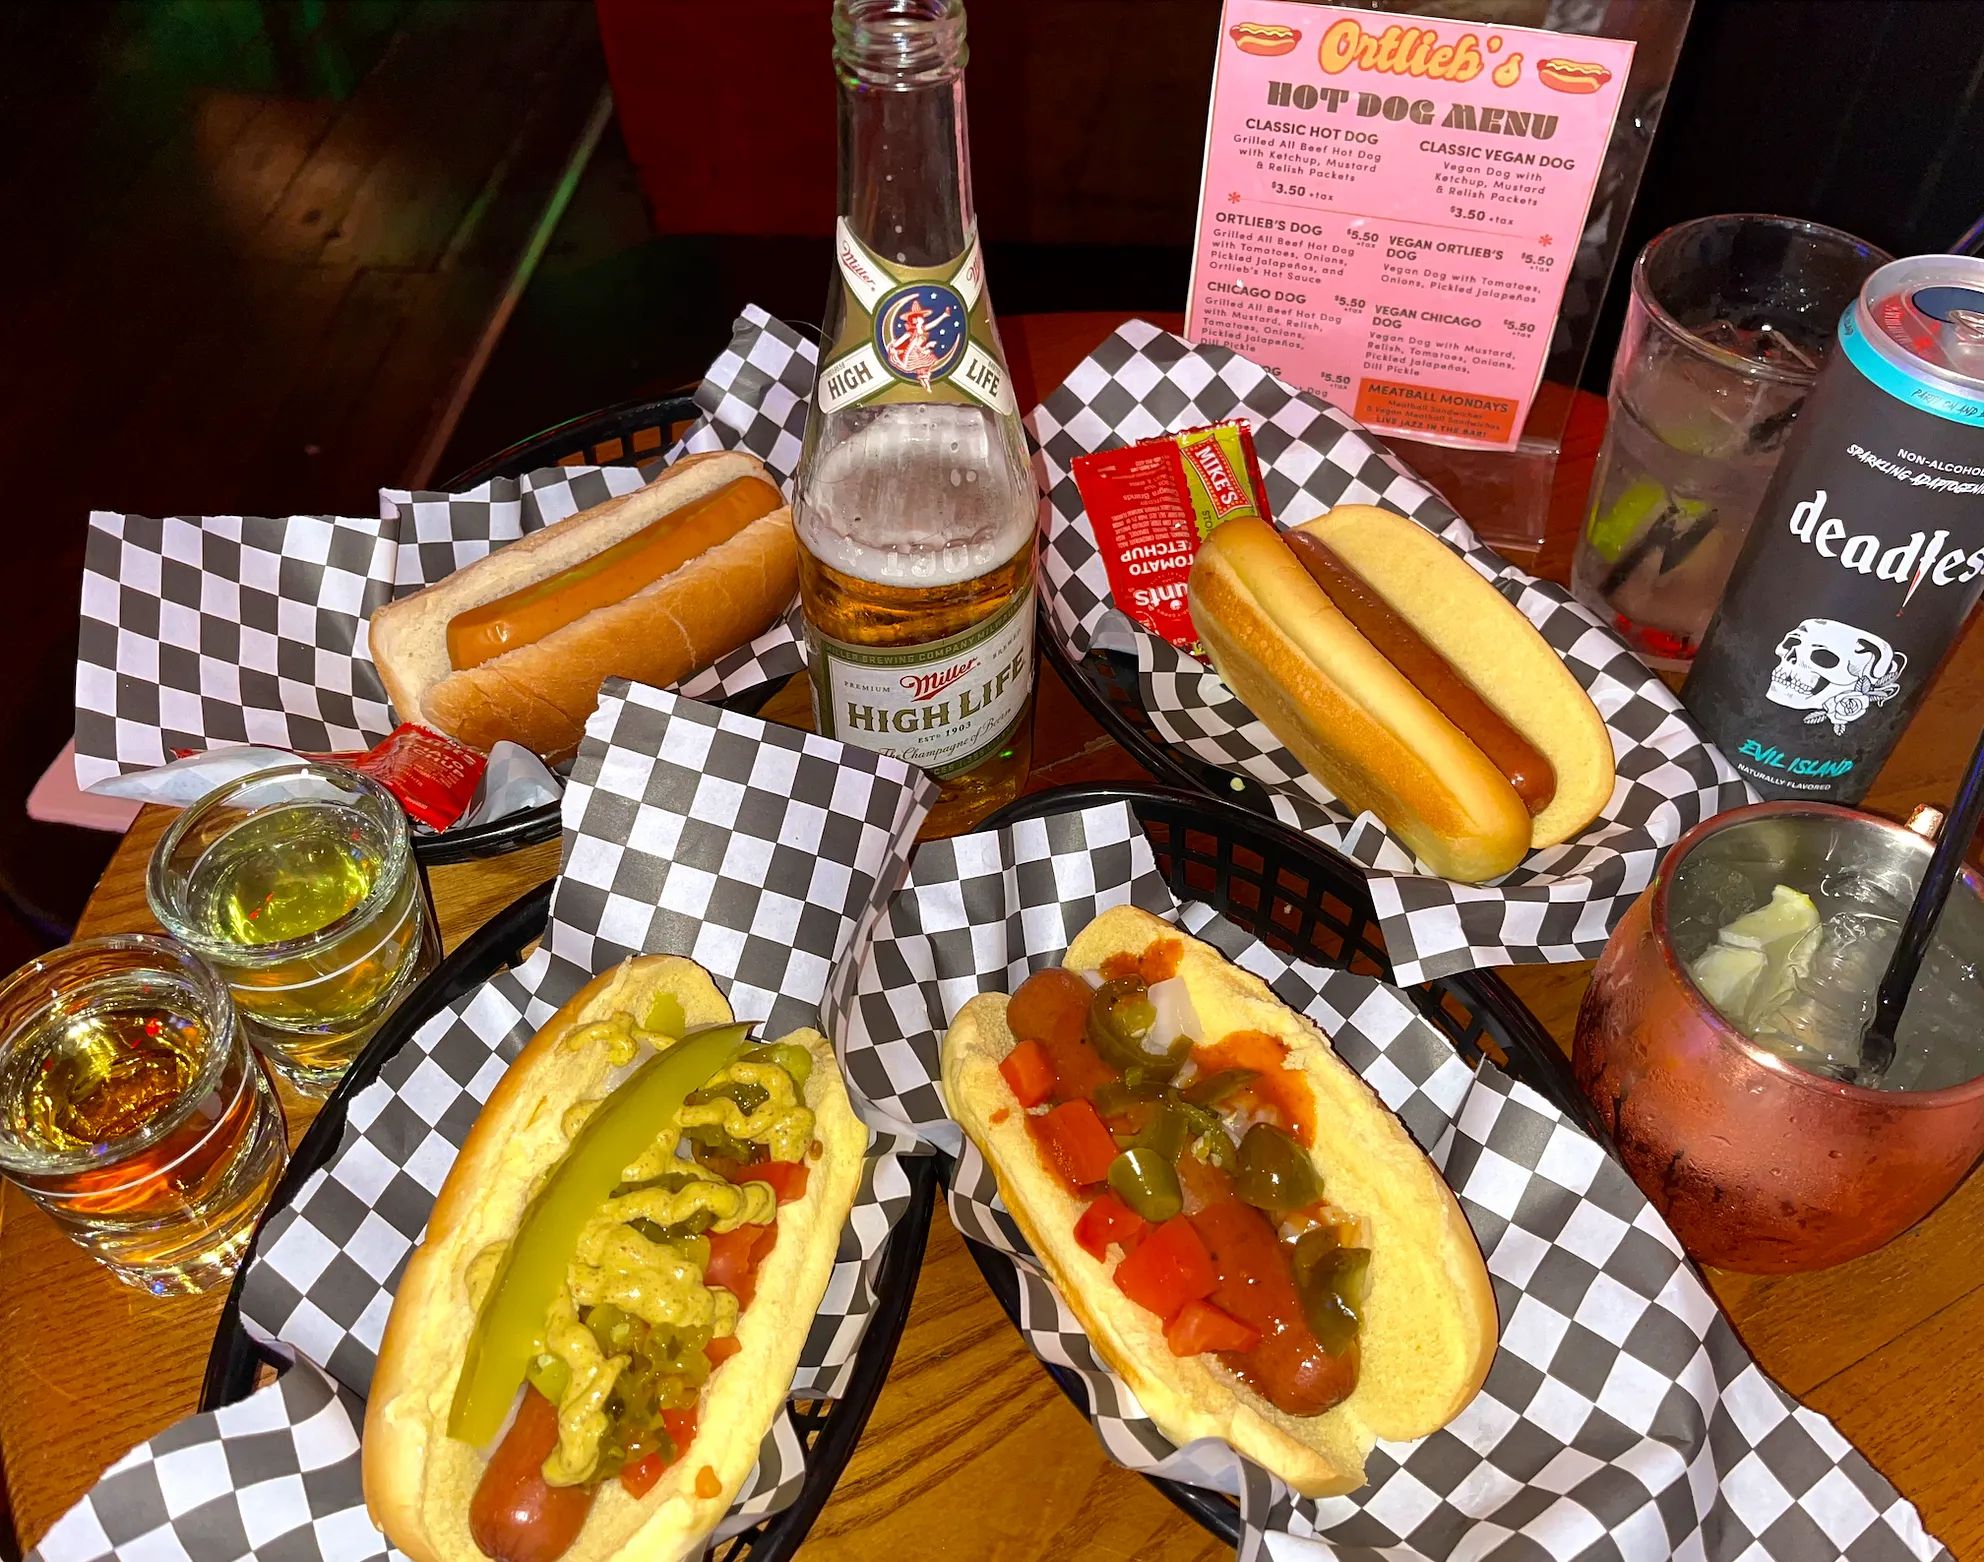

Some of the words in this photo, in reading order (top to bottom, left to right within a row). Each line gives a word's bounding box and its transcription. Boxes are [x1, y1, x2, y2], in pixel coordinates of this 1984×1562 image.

[1318, 18, 1523, 88] Ortlieb's
[1267, 80, 1350, 114] HOT
[1356, 91, 1436, 126] DOG
[1440, 102, 1559, 141] MENU
[1245, 118, 1307, 136] CLASSIC
[1309, 125, 1342, 141] HOT
[1344, 130, 1379, 145] DOG
[1233, 134, 1276, 147] Grilled
[1279, 139, 1296, 150] All
[1299, 142, 1329, 154] Beef
[1332, 146, 1353, 157] Hot
[1357, 150, 1382, 164] Dog
[1238, 147, 1264, 158] with
[1326, 158, 1377, 173] Mustard
[1419, 140, 1483, 159] CLASSIC
[1485, 148, 1536, 166] VEGAN
[1538, 155, 1576, 171] DOG
[1256, 160, 1264, 170] &
[1268, 162, 1304, 175] Relish
[1308, 168, 1355, 182] Packets
[1443, 160, 1481, 174] Vegan
[1486, 166, 1511, 181] Dog
[1515, 171, 1542, 182] with
[1435, 185, 1444, 194] &
[1448, 186, 1485, 199] Relish
[1490, 192, 1538, 206] Packets
[1492, 180, 1546, 195] Mustard
[1215, 211, 1286, 231] ORTLIEB'S
[1289, 221, 1323, 236] DOG
[1211, 240, 1236, 250] with
[1213, 228, 1253, 241] Grilled
[1256, 234, 1273, 244] All
[1277, 237, 1304, 248] Beef
[1307, 241, 1328, 251] Hot
[1331, 244, 1355, 258] Dog
[1386, 248, 1417, 261] DOG
[1389, 235, 1433, 251] VEGAN
[1435, 242, 1504, 261] ORTLIEB'S
[841, 240, 875, 286] Miller
[1210, 250, 1253, 263] Pickled
[1321, 267, 1344, 276] and
[1383, 263, 1419, 276] Vegan
[1423, 268, 1447, 282] Dog
[1451, 274, 1477, 284] with
[1263, 268, 1283, 279] Hot
[1287, 271, 1322, 284] Sauce
[1429, 281, 1473, 295] Pickled
[1207, 281, 1271, 299] CHICAGO
[1274, 290, 1307, 305] DOG
[1203, 308, 1227, 317] with
[1204, 296, 1244, 309] Grilled
[1246, 302, 1263, 312] All
[1266, 305, 1293, 316] Beef
[1296, 309, 1316, 320] Hot
[1319, 312, 1342, 326] Dog
[1371, 316, 1403, 329] DOG
[1375, 304, 1418, 320] VEGAN
[1420, 311, 1482, 329] CHICAGO
[1201, 327, 1242, 340] Pickled
[1369, 330, 1404, 343] Vegan
[1408, 336, 1431, 349] Dog
[1435, 341, 1460, 351] with
[1363, 361, 1383, 371] Dill
[1386, 364, 1420, 377] Pickle
[1365, 351, 1407, 364] Pickled
[828, 361, 874, 400] HIGH
[966, 358, 1000, 398] LIFE
[1262, 365, 1282, 376] OG
[1367, 383, 1437, 402] MEATBALL
[1439, 394, 1509, 413] MONDAYS
[1195, 445, 1239, 506] MIKE'S
[1789, 489, 1984, 607] deadles
[862, 654, 914, 665] BREWING
[919, 638, 976, 661] COMPANY
[844, 681, 891, 693] PREMIUM
[848, 701, 951, 733] HIGH
[959, 646, 1025, 721] LIFE
[899, 656, 979, 703] Miller
[945, 720, 972, 737] 1903
[901, 737, 969, 760] Champagne
[969, 725, 983, 747] of
[1738, 738, 1785, 768] EVIL
[1786, 758, 1856, 779] ISLAND
[1738, 763, 1786, 786] NATURALLY
[1787, 780, 1832, 792] FLAVORED
